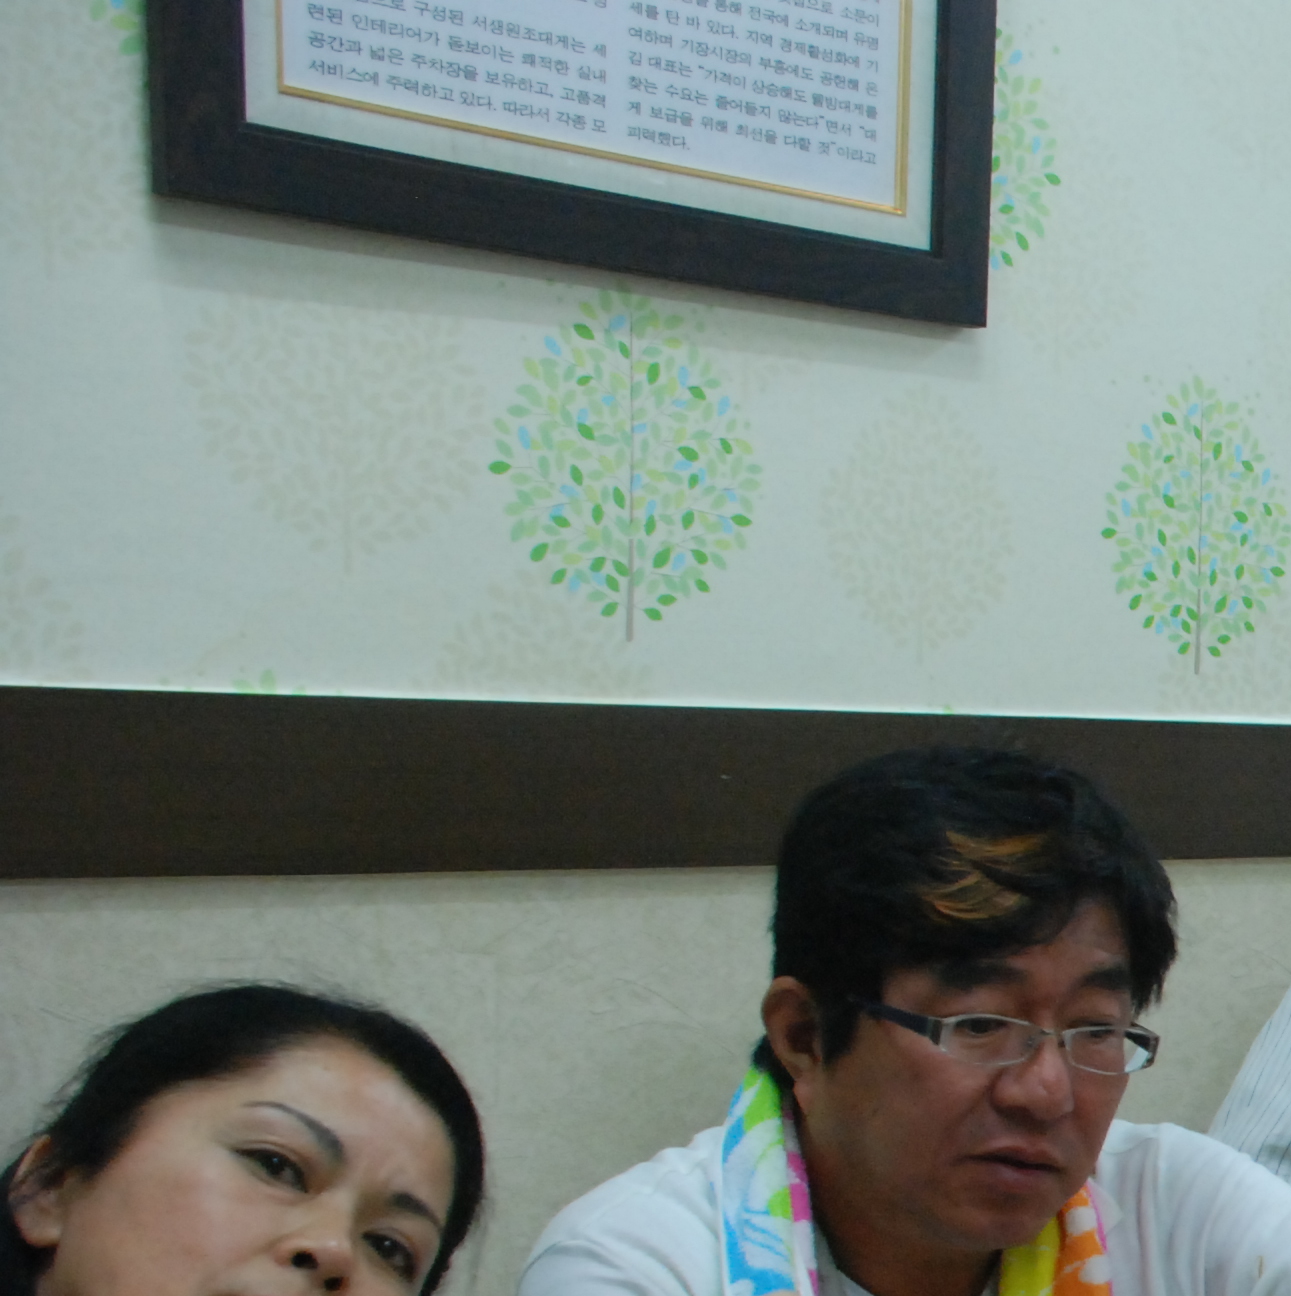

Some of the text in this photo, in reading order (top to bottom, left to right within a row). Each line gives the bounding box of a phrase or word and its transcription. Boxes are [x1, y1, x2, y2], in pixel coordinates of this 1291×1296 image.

[414, 1, 464, 26] 구성된
[473, 16, 586, 54] 서생원조대게는
[630, 2, 879, 74] 세를 탄 바 있다. 지역 경제활성화에 기
[748, 6, 789, 27] 전국에
[795, 18, 848, 42] 소개되며
[853, 31, 879, 51] 유명
[840, 7, 879, 27] 소문이
[308, 30, 607, 108] 공간과 넓은 주차장을 보유하고, 고품격
[352, 14, 440, 47] 인테리어가
[521, 53, 570, 76] 쾌적한
[578, 65, 607, 84] 실내
[628, 27, 673, 49] 여하며
[681, 40, 752, 67] 기장시장의
[759, 56, 814, 81] 부흥에도
[309, 60, 607, 133] 서비스에 주력하고 있다. 따라서 각종 모
[628, 75, 658, 95] 찾는
[665, 84, 709, 106] 수요는
[716, 95, 771, 119] 줄어들지
[629, 50, 642, 66] 김
[648, 57, 693, 78] 대표는
[752, 80, 807, 103] 상승해도
[627, 126, 690, 151] 피력했다.
[628, 101, 641, 116] 게
[650, 106, 694, 127] 보급을
[701, 116, 728, 134] 위해
[736, 124, 777, 145] 최선을
[783, 134, 811, 152] 다할
